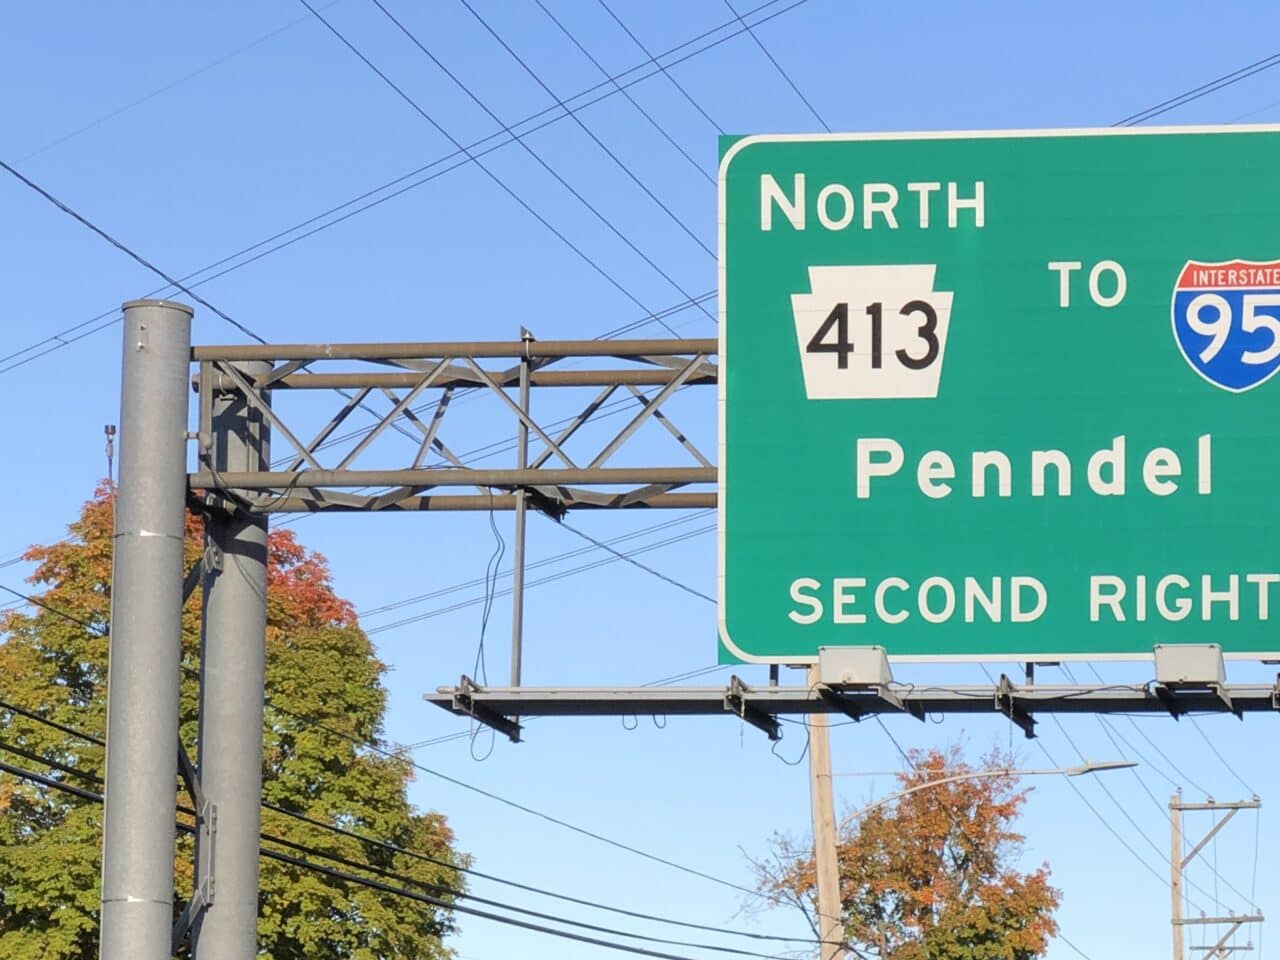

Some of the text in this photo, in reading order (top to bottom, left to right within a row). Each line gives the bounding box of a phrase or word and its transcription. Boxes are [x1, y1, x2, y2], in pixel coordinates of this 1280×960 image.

[761, 174, 984, 231] NORTH
[1048, 261, 1127, 308] TO
[1193, 267, 1280, 286] INTERSTATE
[806, 300, 939, 370] 413
[856, 434, 1211, 498] Penndel
[788, 573, 1280, 625] SECOND RIGHT
